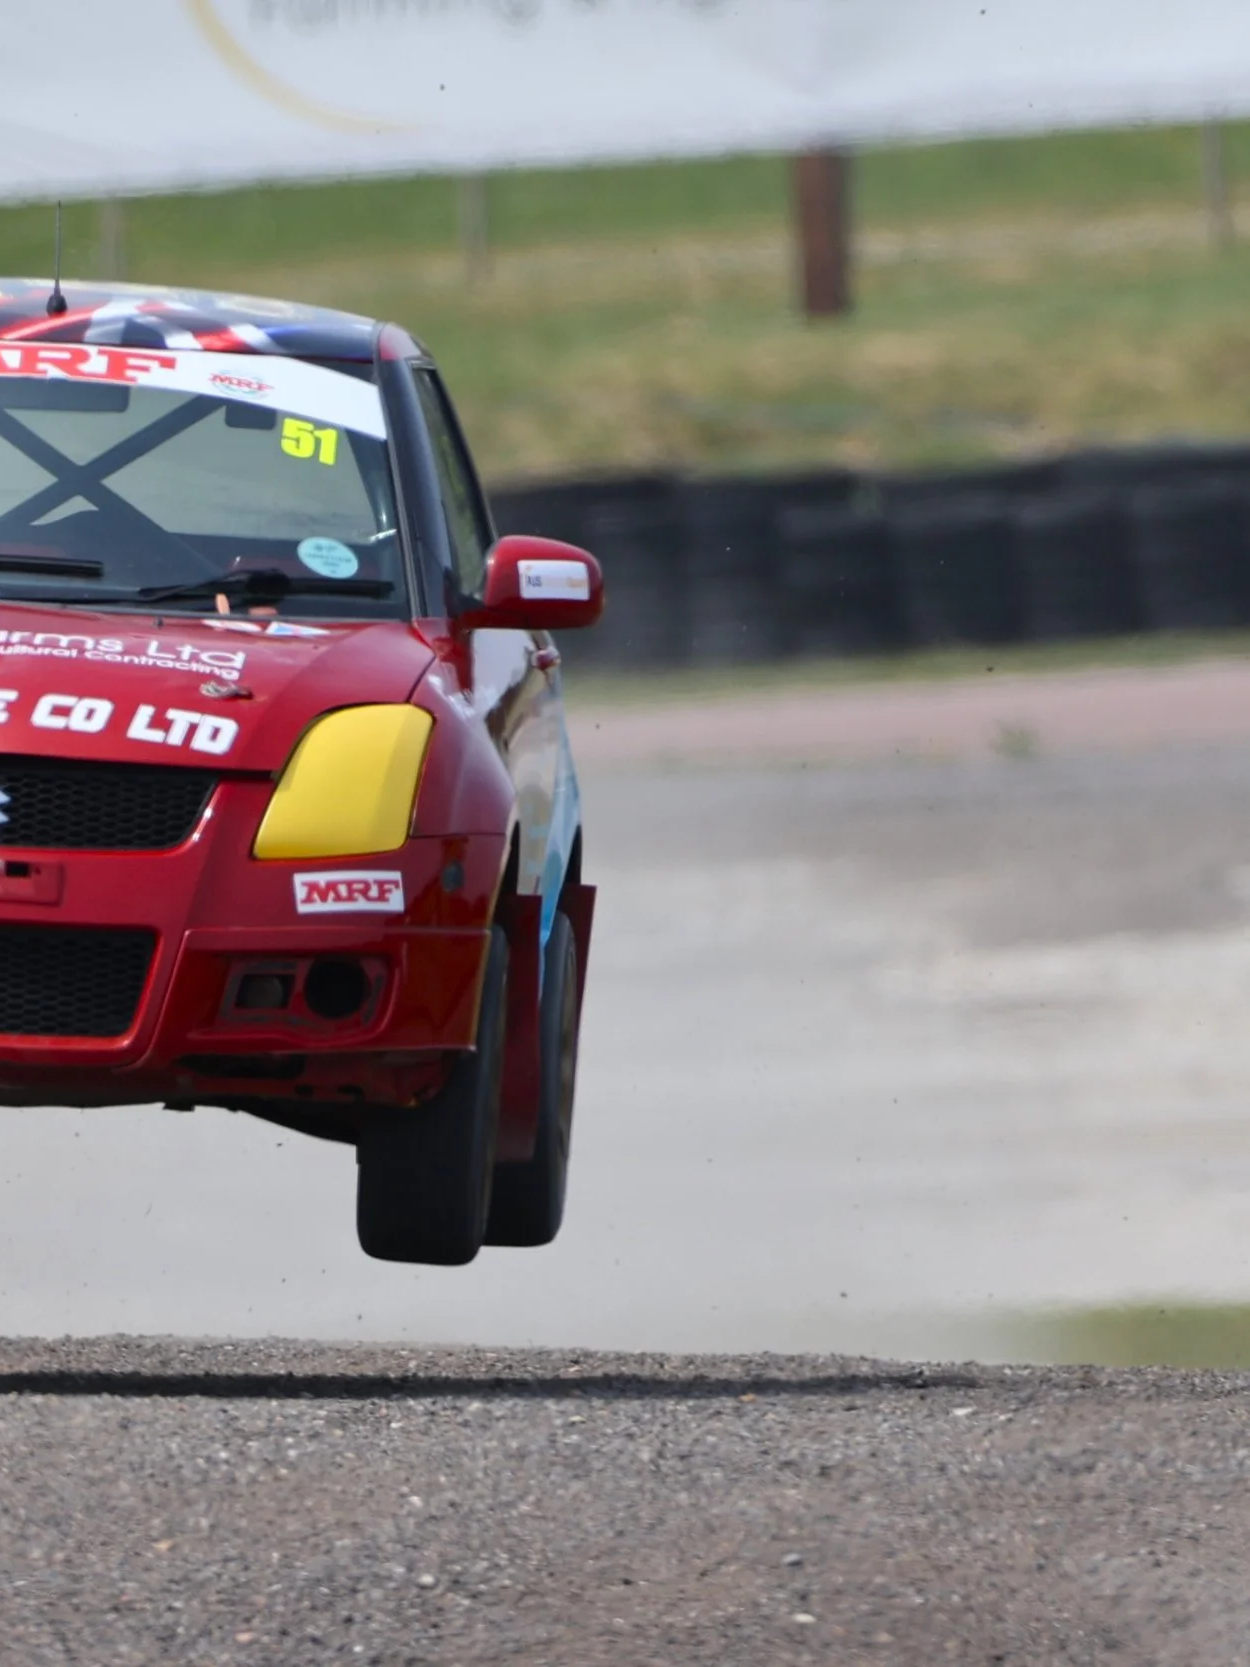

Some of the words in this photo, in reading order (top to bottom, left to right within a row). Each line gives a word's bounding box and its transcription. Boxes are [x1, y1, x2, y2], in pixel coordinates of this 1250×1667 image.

[208, 372, 275, 392] MRF
[280, 417, 339, 466] 51
[85, 649, 240, 681] Contracting
[146, 639, 246, 670] Ltd
[31, 694, 114, 734] CO
[126, 704, 240, 756] LTD
[300, 878, 401, 905] MRF
